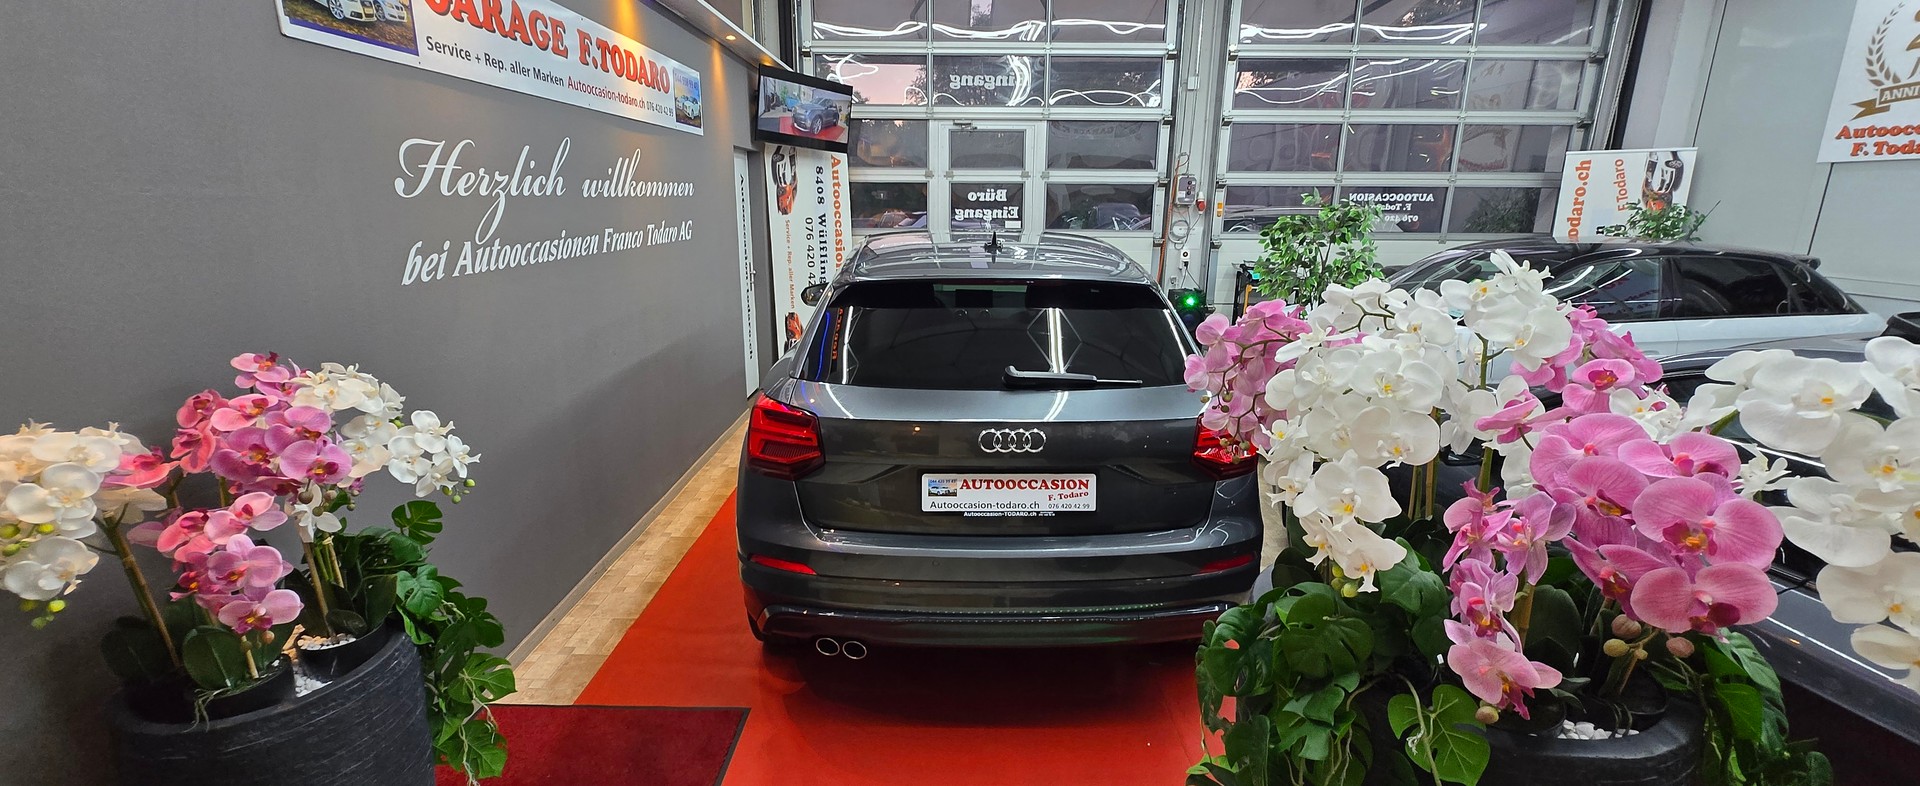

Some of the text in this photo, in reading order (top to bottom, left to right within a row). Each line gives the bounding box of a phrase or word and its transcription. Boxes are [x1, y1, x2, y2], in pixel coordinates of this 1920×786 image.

[426, 36, 472, 62] Service
[475, 54, 481, 64] +
[484, 53, 507, 73] Rep.
[510, 61, 531, 78] aller
[533, 67, 565, 87] Marken
[568, 76, 645, 109] Autooccasion-todaro.ch
[1850, 142, 1869, 157] F.
[394, 137, 694, 245] Herzlich willkommen
[815, 166, 825, 205] 8408
[1613, 158, 1628, 203] Todaro
[805, 217, 814, 240] 076
[401, 220, 693, 286] bei Autooccasionen Franco Todaro AG
[807, 245, 816, 268] 420
[960, 478, 1090, 490] AUTOOCCASION
[1058, 491, 1089, 500] Todaro
[930, 501, 1040, 509] Autooccasion-todaro.ch
